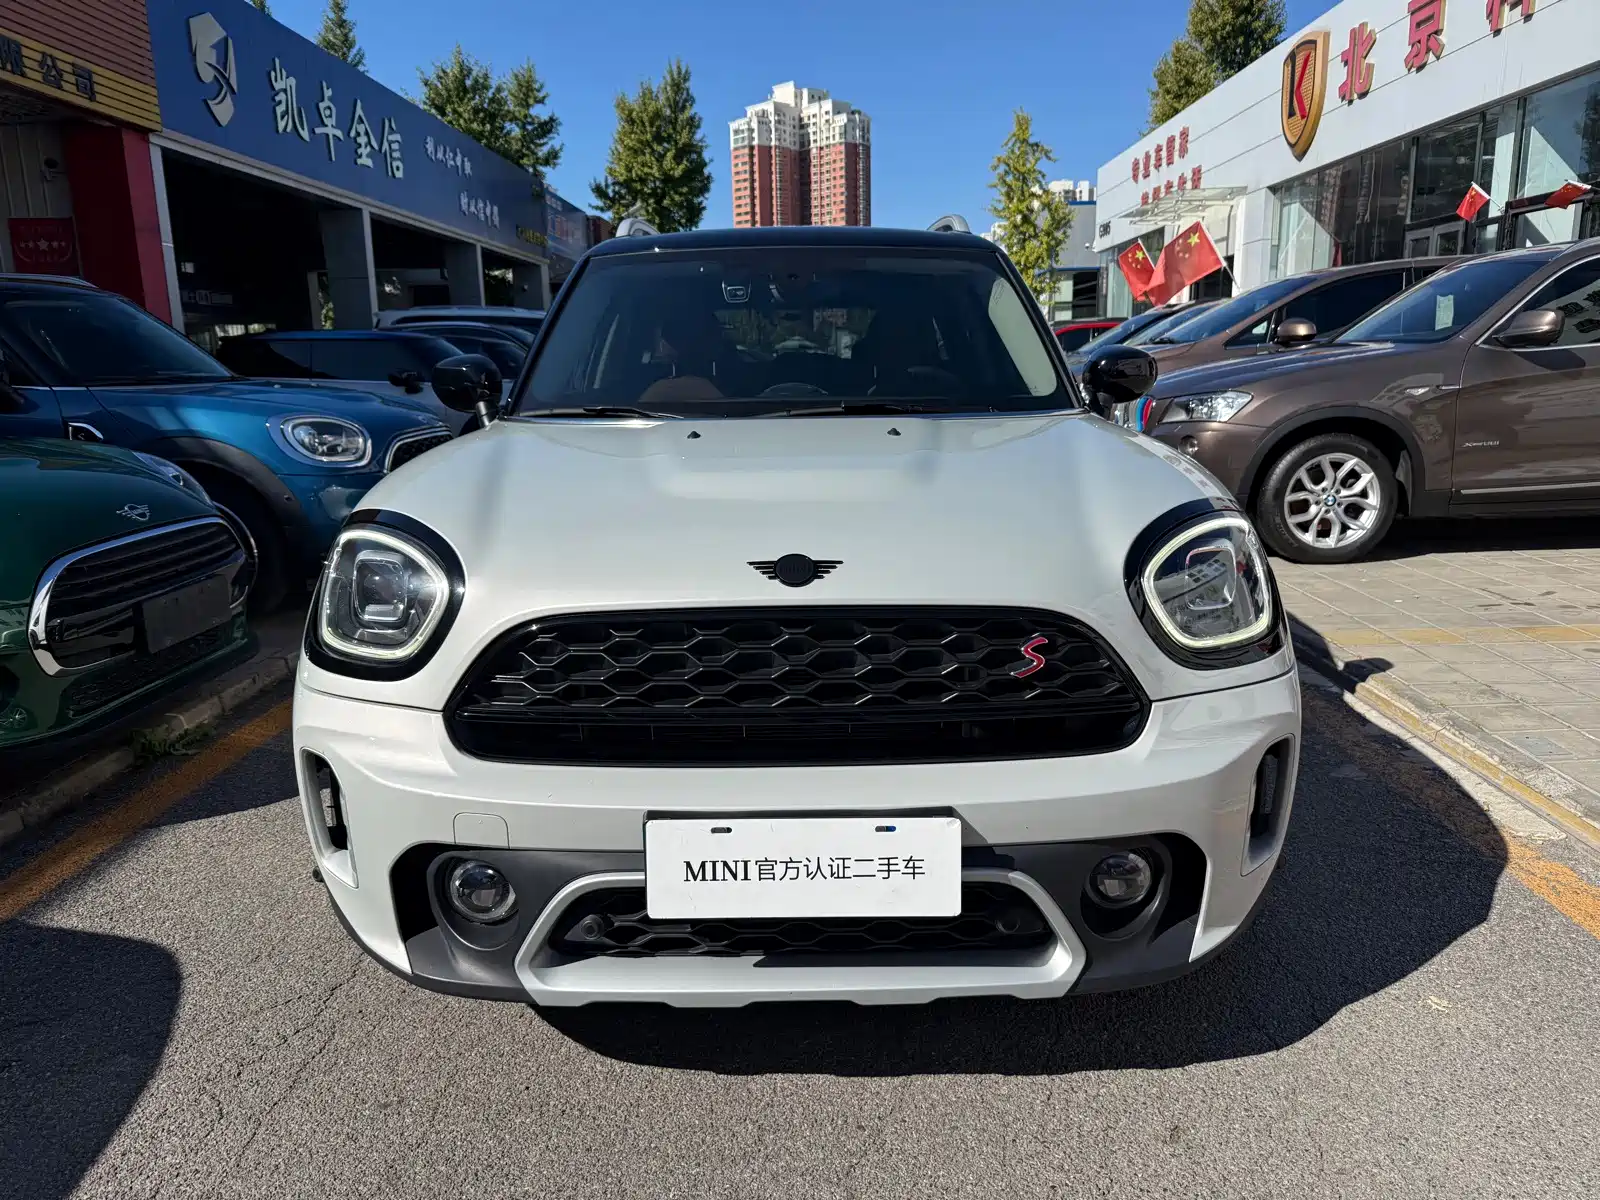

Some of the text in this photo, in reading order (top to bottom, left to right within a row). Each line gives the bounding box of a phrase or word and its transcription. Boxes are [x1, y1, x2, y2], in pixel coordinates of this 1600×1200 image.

[269, 57, 404, 179] 凯卓金信
[1131, 126, 1190, 184] 专业车管家
[1010, 636, 1049, 678] S
